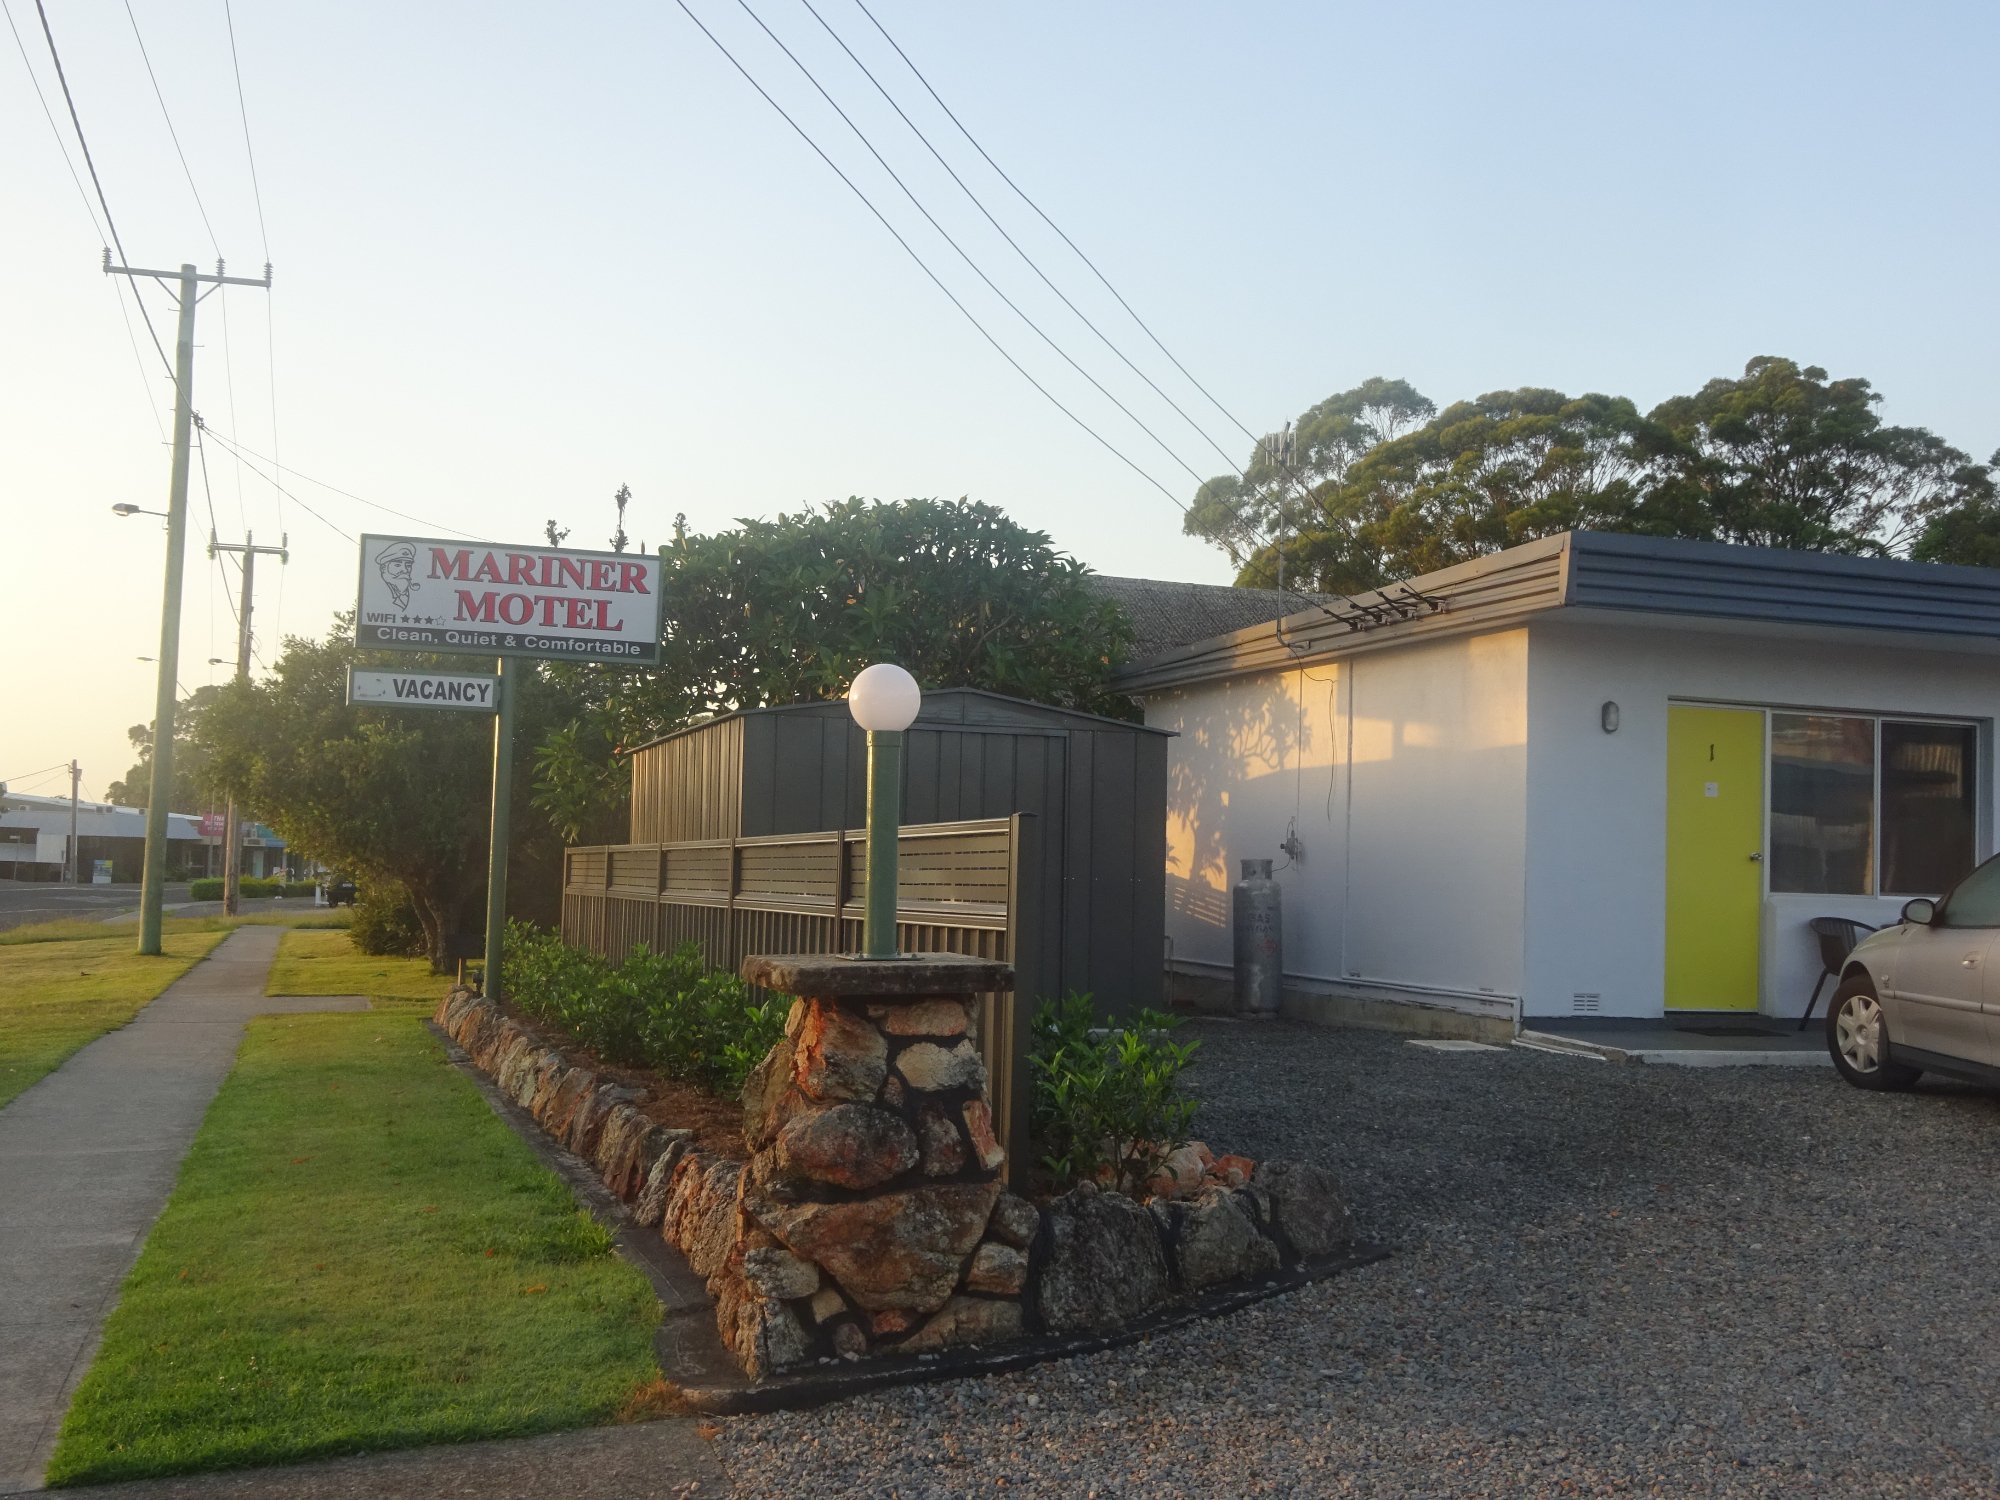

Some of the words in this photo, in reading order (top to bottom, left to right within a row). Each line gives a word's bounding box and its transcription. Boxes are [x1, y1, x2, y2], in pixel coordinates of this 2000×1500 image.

[427, 547, 651, 594] MARINER
[366, 612, 396, 624] WIFI
[453, 589, 624, 632] MOTEL
[377, 627, 438, 644] Clean,
[445, 630, 497, 647] Quiet
[504, 635, 517, 647] &
[524, 636, 641, 656] Comfortable
[392, 678, 490, 703] VACANCY
